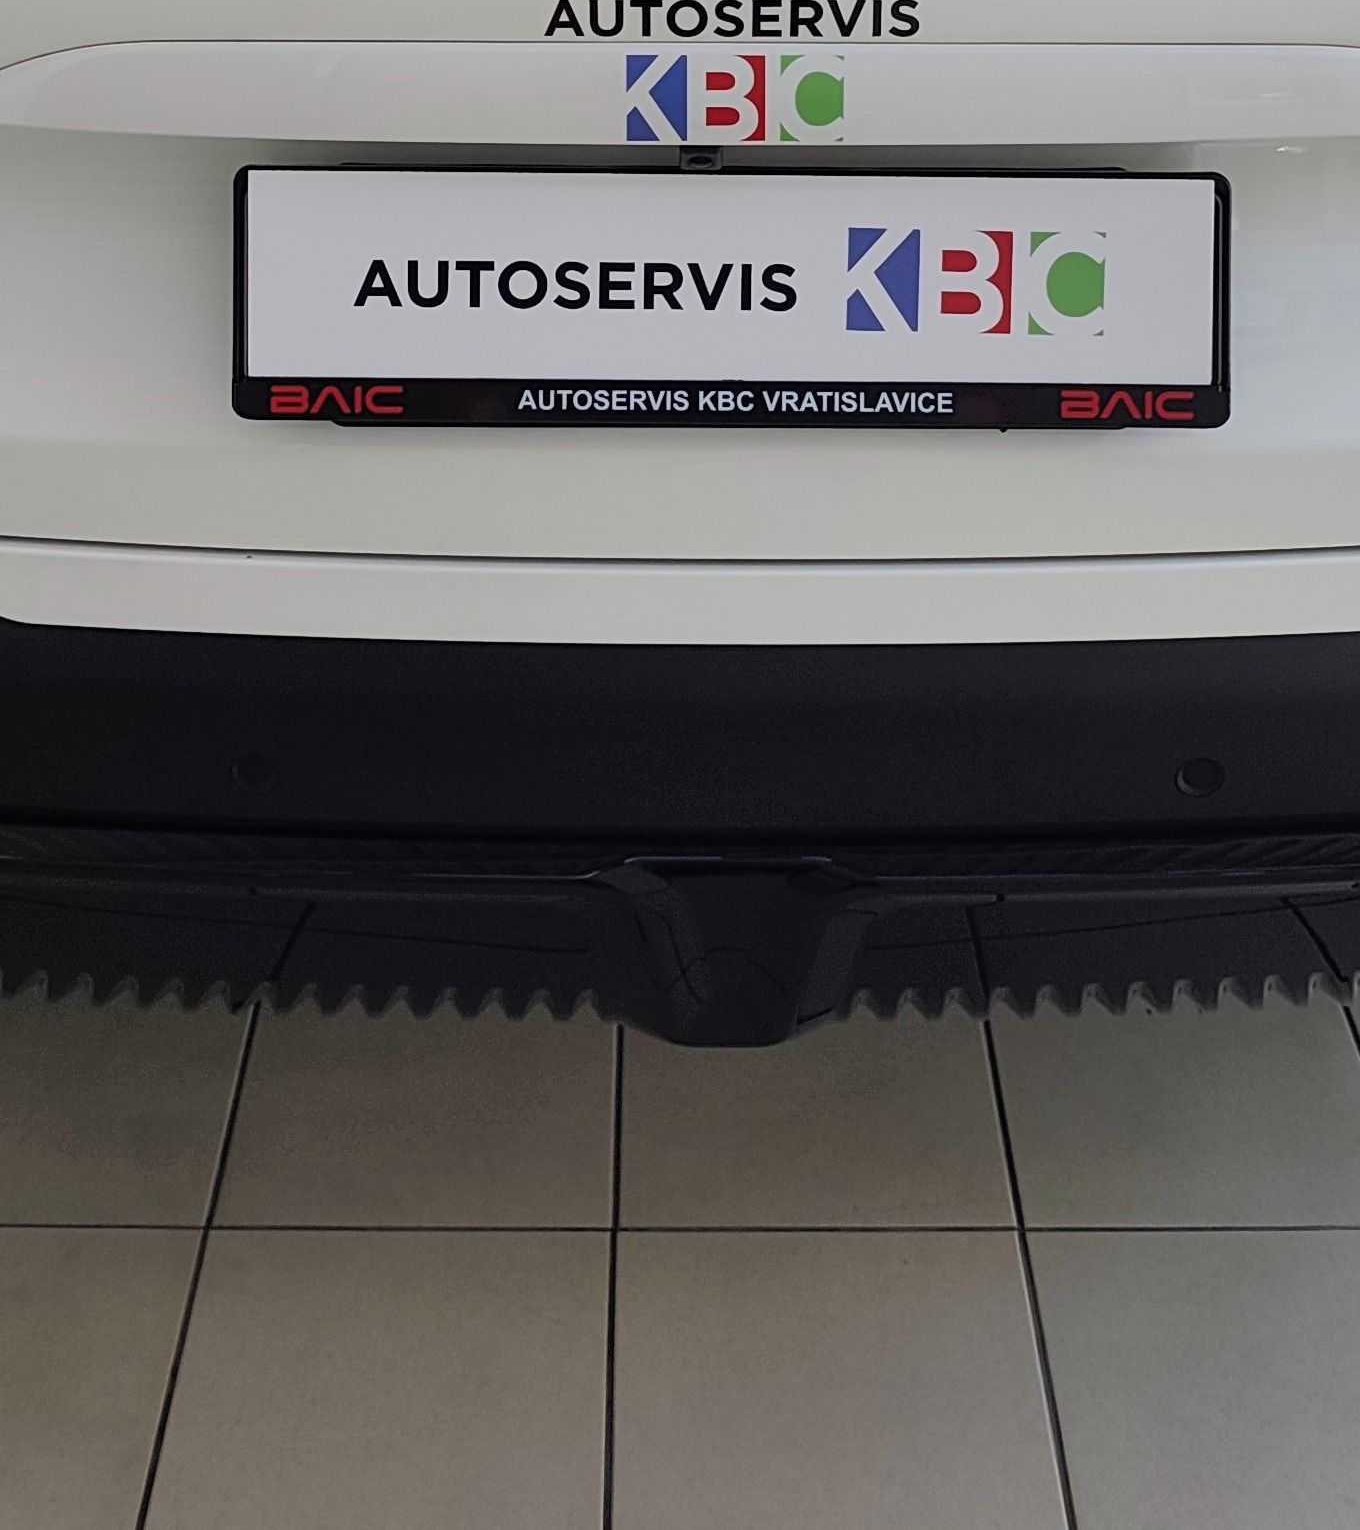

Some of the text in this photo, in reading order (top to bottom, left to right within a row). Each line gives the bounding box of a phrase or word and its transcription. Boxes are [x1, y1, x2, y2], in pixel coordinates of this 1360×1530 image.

[625, 54, 845, 142] KBC
[352, 226, 1107, 337] AUTOSERVIS KBC
[269, 385, 405, 415] BAIC
[517, 389, 954, 414] AUTOSERVIS KBC VRATISLAVICE
[1060, 390, 1195, 420] BAIC
